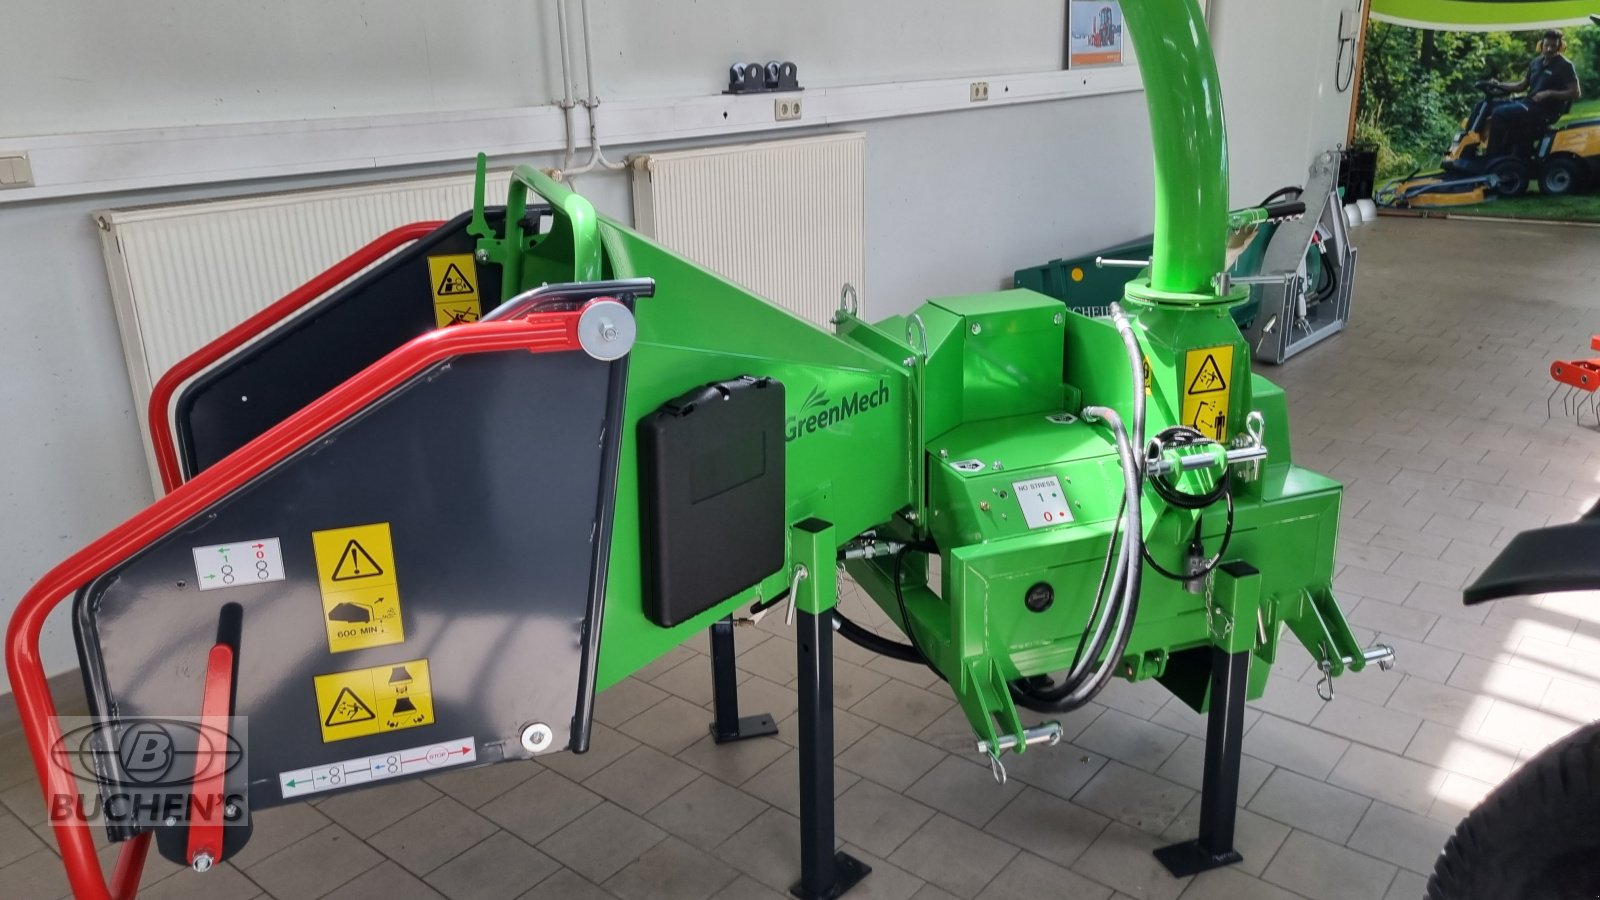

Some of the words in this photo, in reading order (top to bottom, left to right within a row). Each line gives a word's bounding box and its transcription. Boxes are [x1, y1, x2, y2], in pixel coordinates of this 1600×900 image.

[785, 379, 889, 442] GreenMech
[1030, 480, 1055, 489] STRESS
[1037, 492, 1044, 502] 1
[1044, 511, 1053, 522] 0
[337, 629, 357, 638] 600
[360, 626, 377, 635] MIN
[429, 752, 446, 760] STOP
